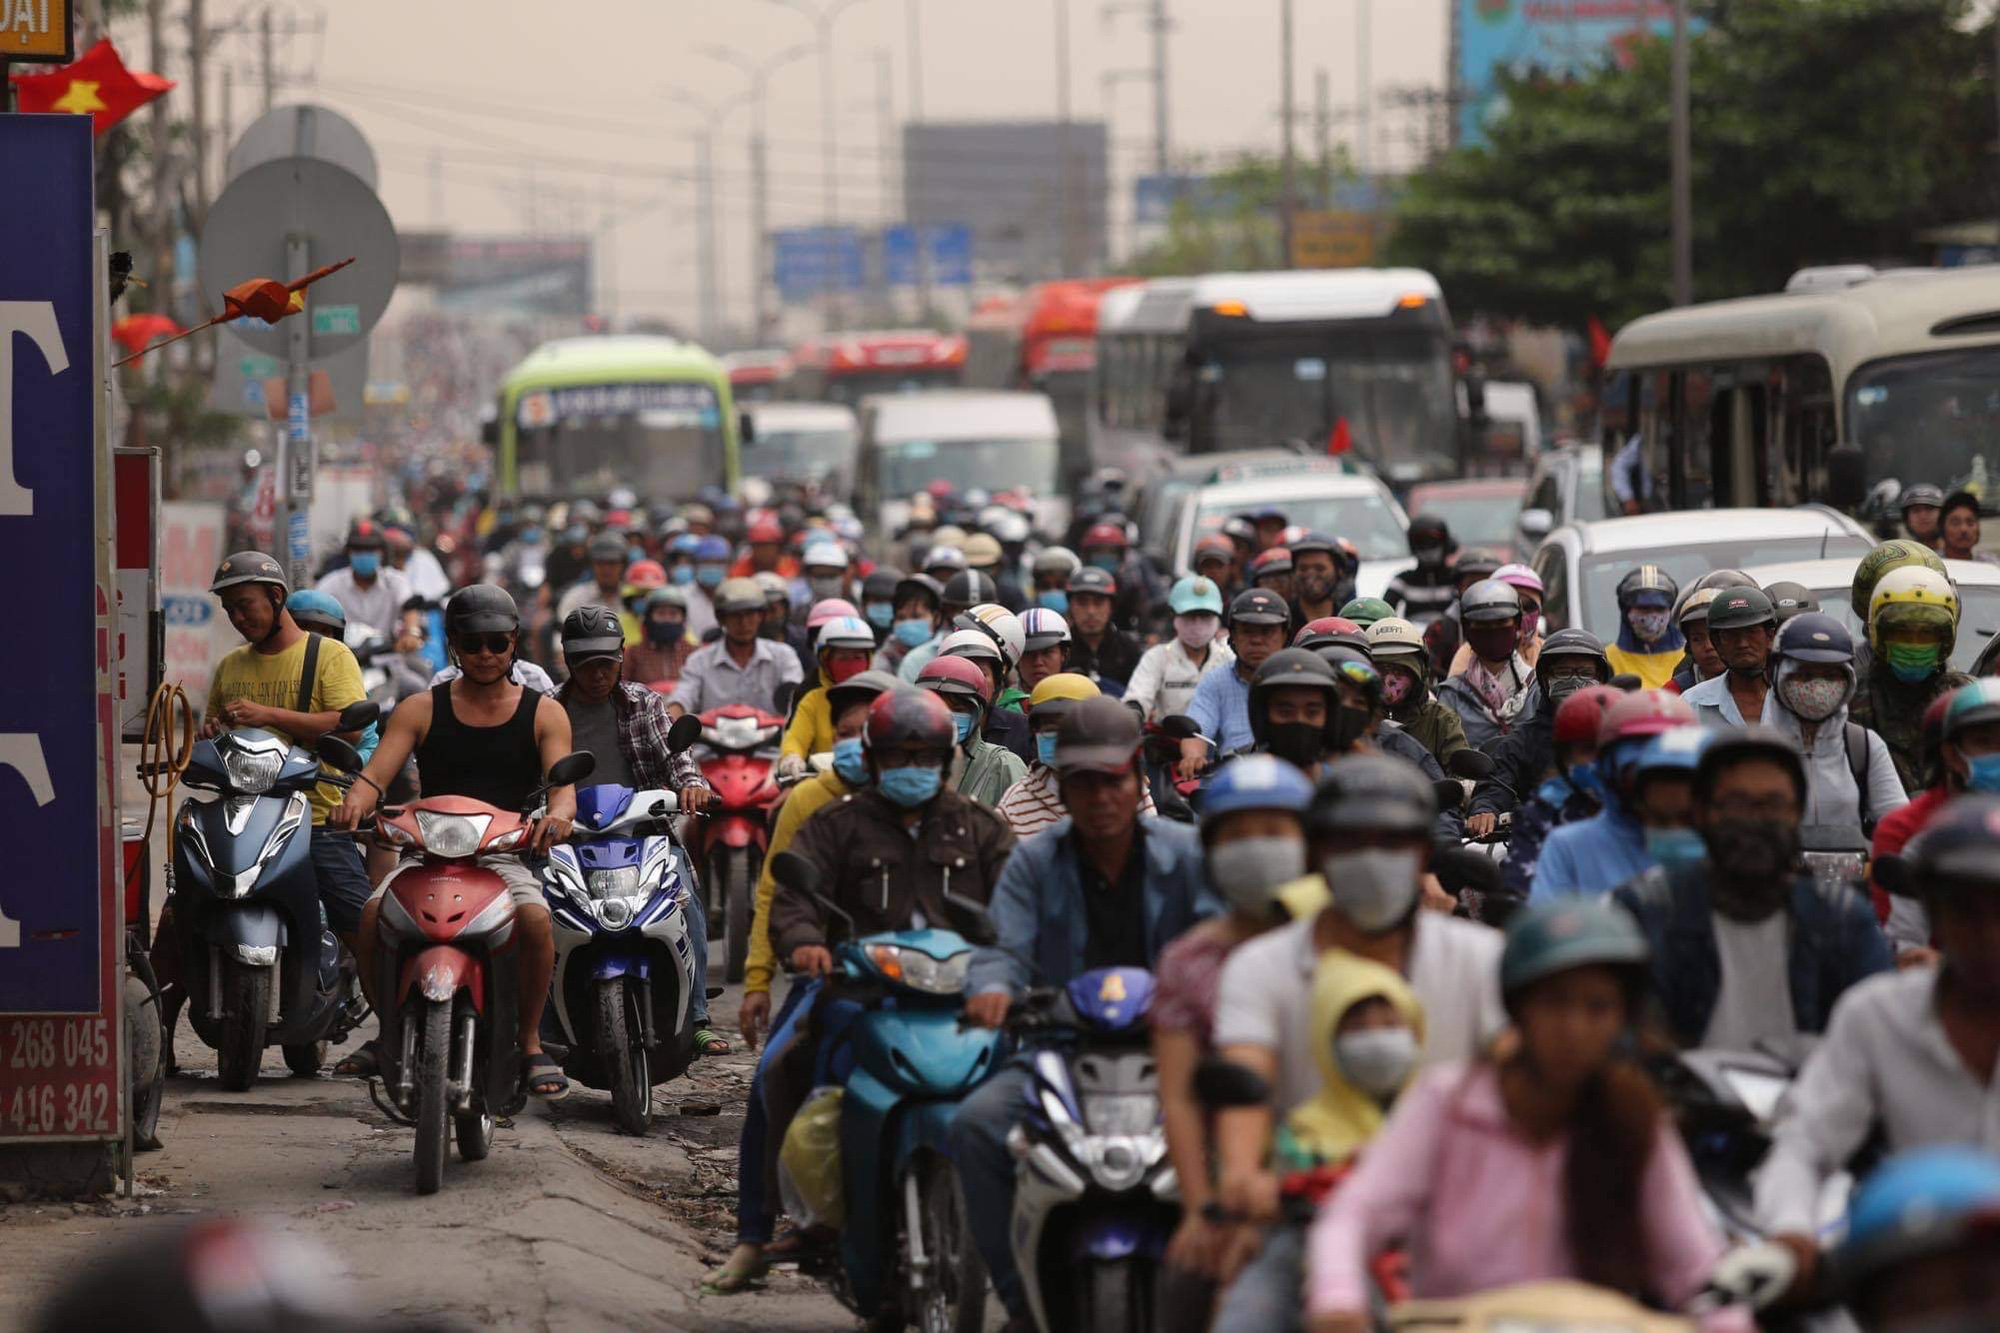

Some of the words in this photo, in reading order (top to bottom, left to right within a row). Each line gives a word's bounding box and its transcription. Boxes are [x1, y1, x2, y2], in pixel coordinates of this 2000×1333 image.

[11, 1020, 56, 1069] 268
[64, 1018, 109, 1067] 045
[10, 1084, 56, 1132] 416
[64, 1082, 109, 1132] 342
